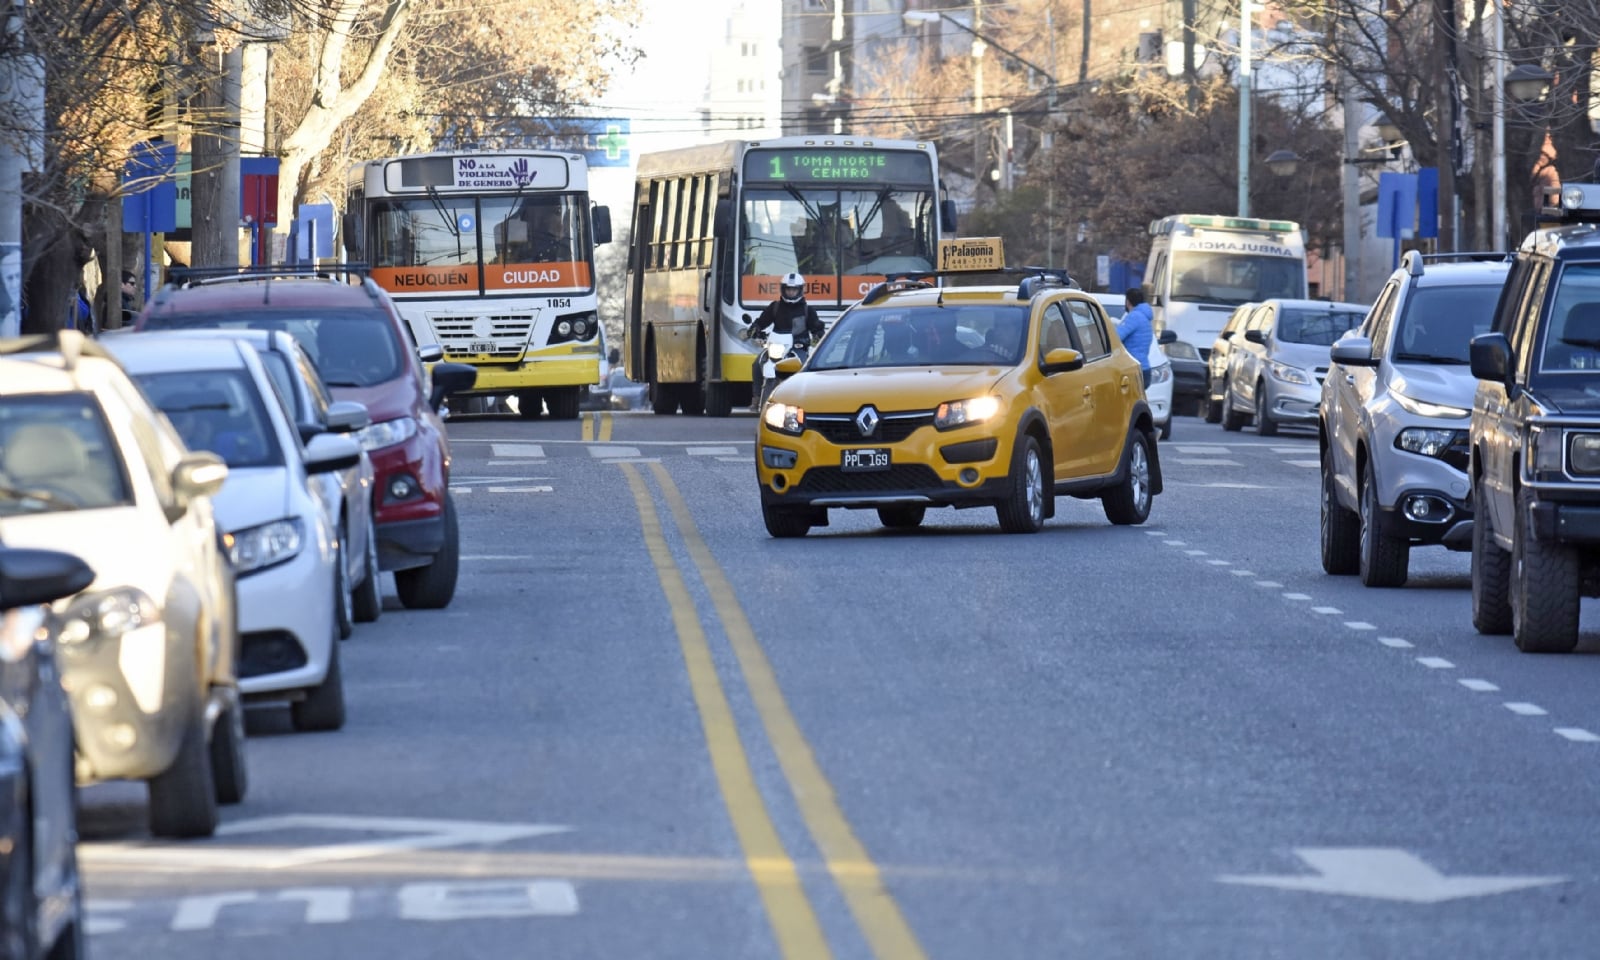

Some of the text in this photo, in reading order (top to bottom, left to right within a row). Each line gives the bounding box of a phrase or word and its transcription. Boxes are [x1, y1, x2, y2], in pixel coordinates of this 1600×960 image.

[459, 159, 476, 170] NO
[769, 156, 785, 178] 1
[793, 156, 886, 167] TOMA NORTE
[811, 168, 869, 178] CENTRO
[951, 245, 993, 257] Patagonia
[394, 270, 468, 286] NEUQUÉN
[503, 269, 561, 284] CIUDAD
[547, 299, 571, 308] 1054
[845, 454, 888, 467] PPL 169
